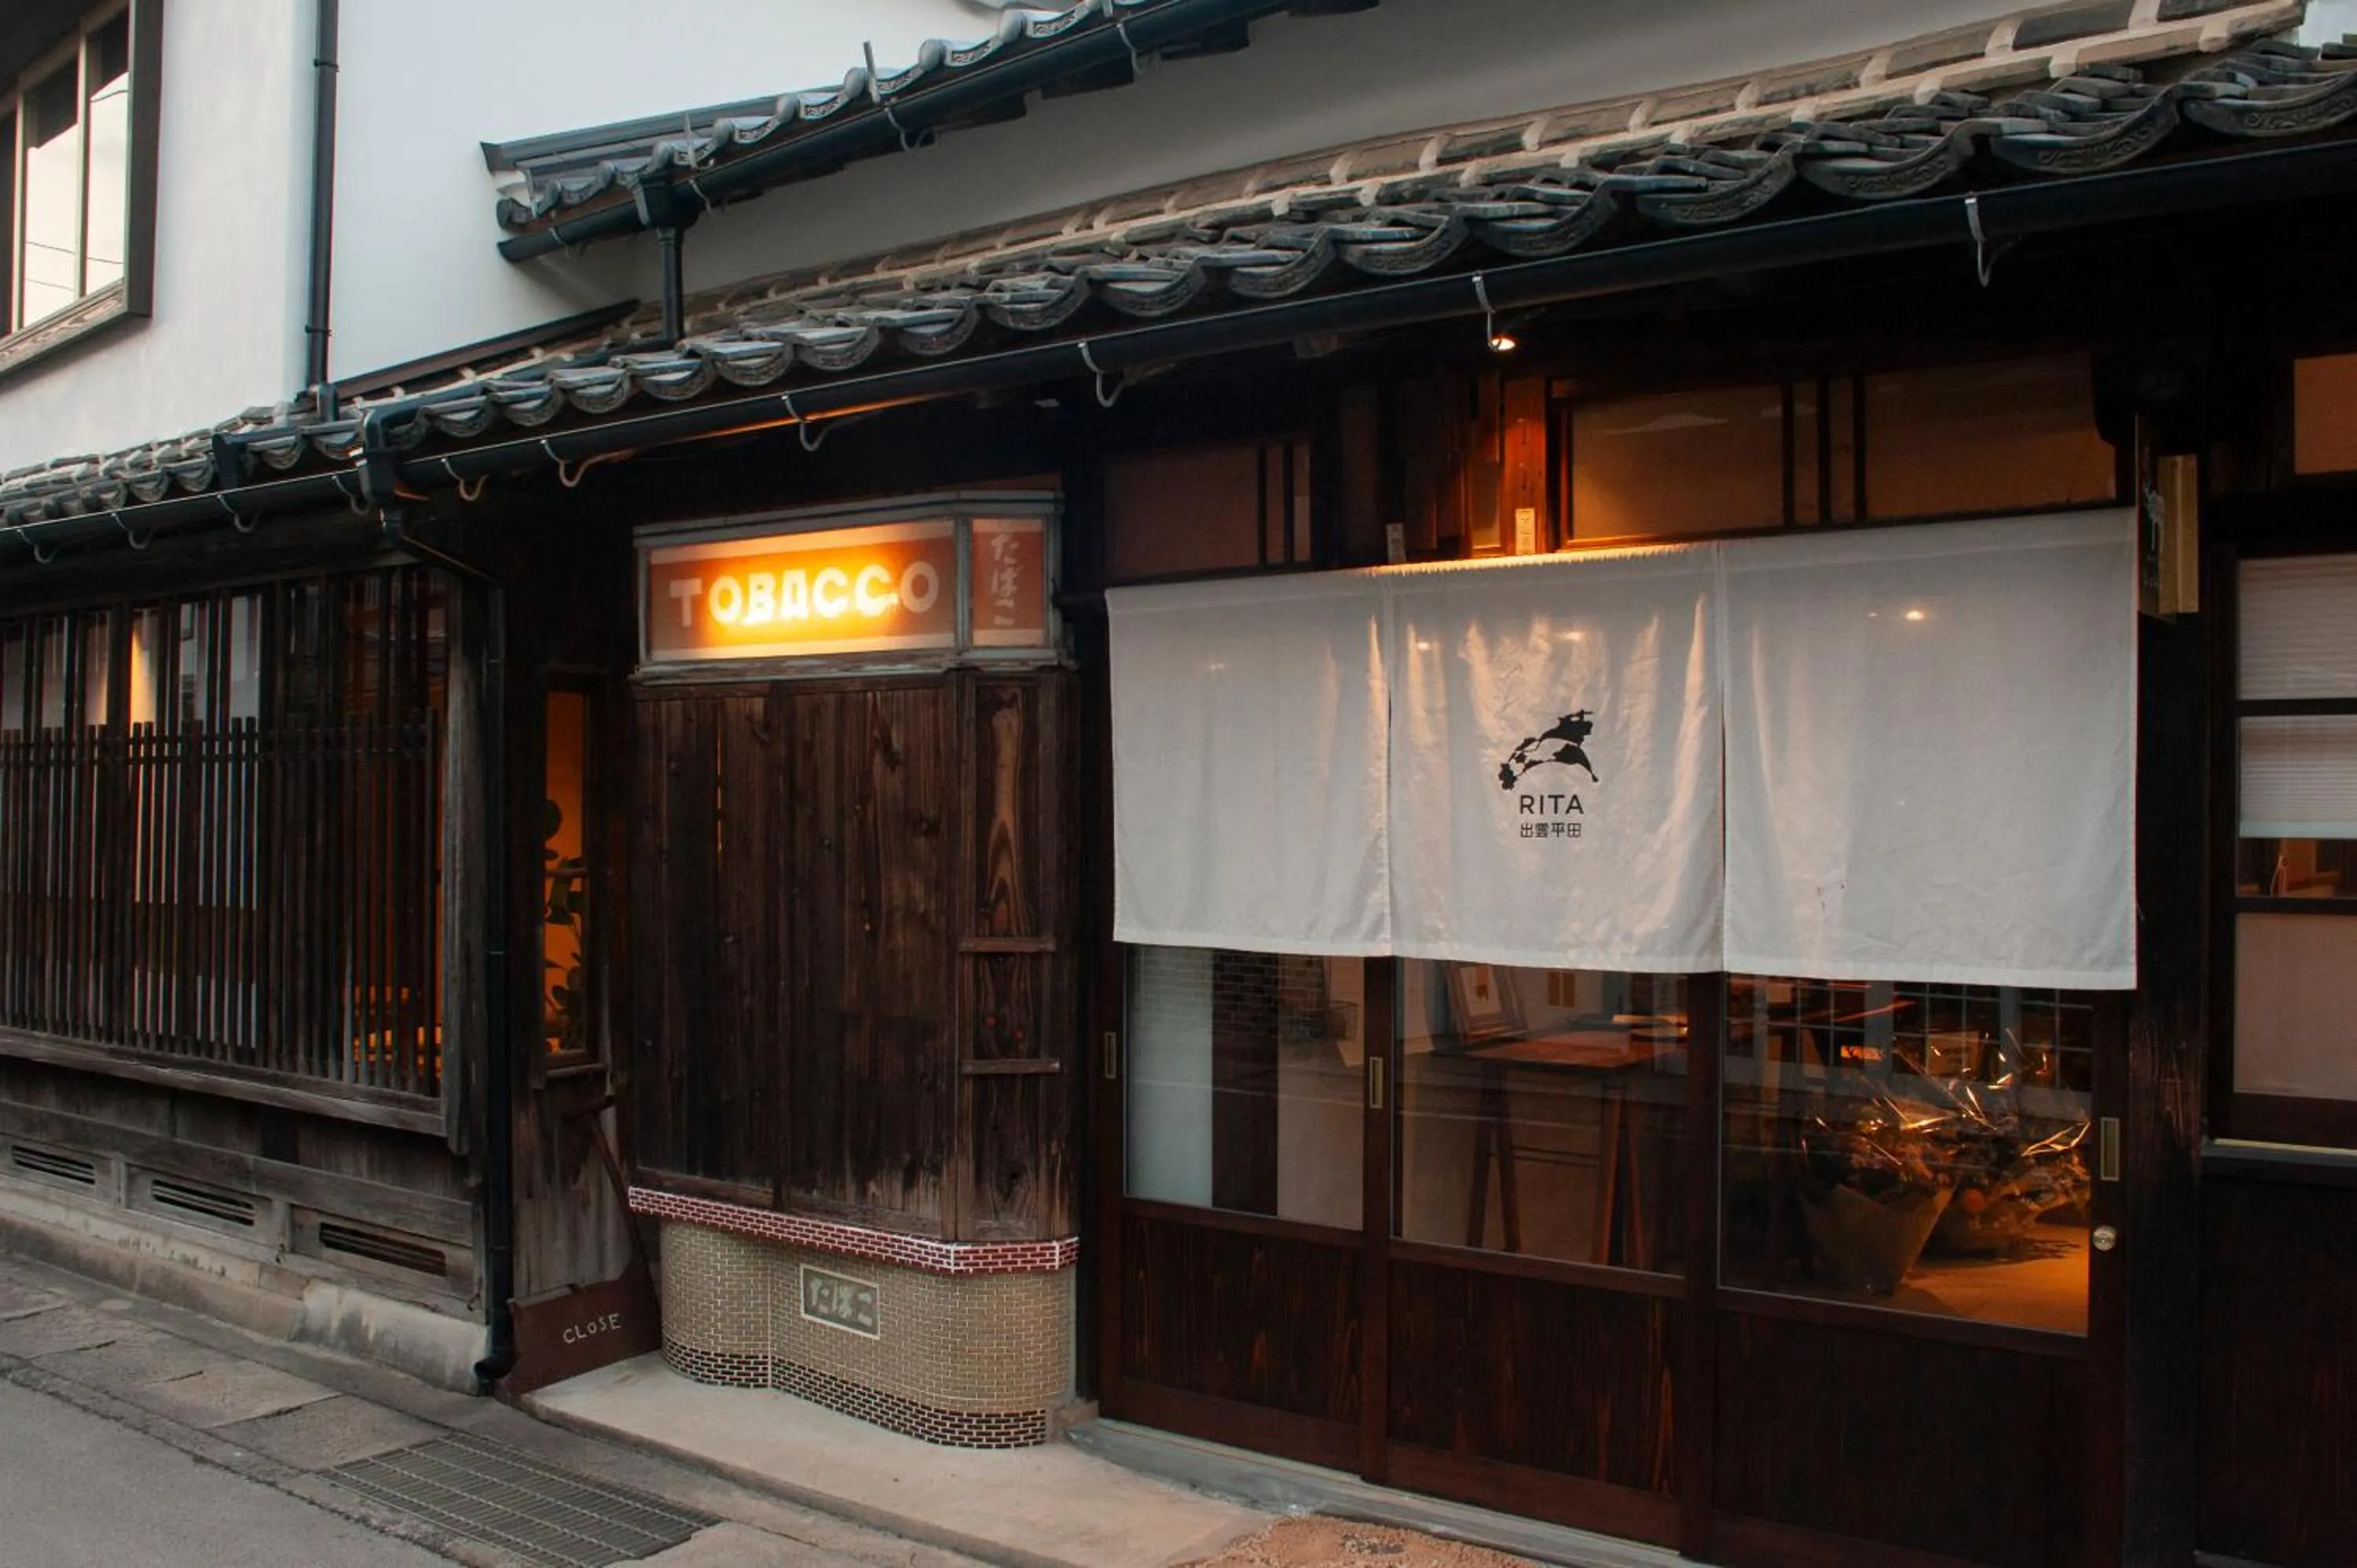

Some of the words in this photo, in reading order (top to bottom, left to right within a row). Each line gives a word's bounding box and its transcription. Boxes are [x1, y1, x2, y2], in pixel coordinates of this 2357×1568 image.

[991, 533, 1022, 625] たばこ
[669, 562, 940, 628] TOBACCO
[1519, 794, 1584, 814] RITA
[1520, 822, 1582, 838] 出雲平田
[563, 1313, 621, 1343] CLOSE
